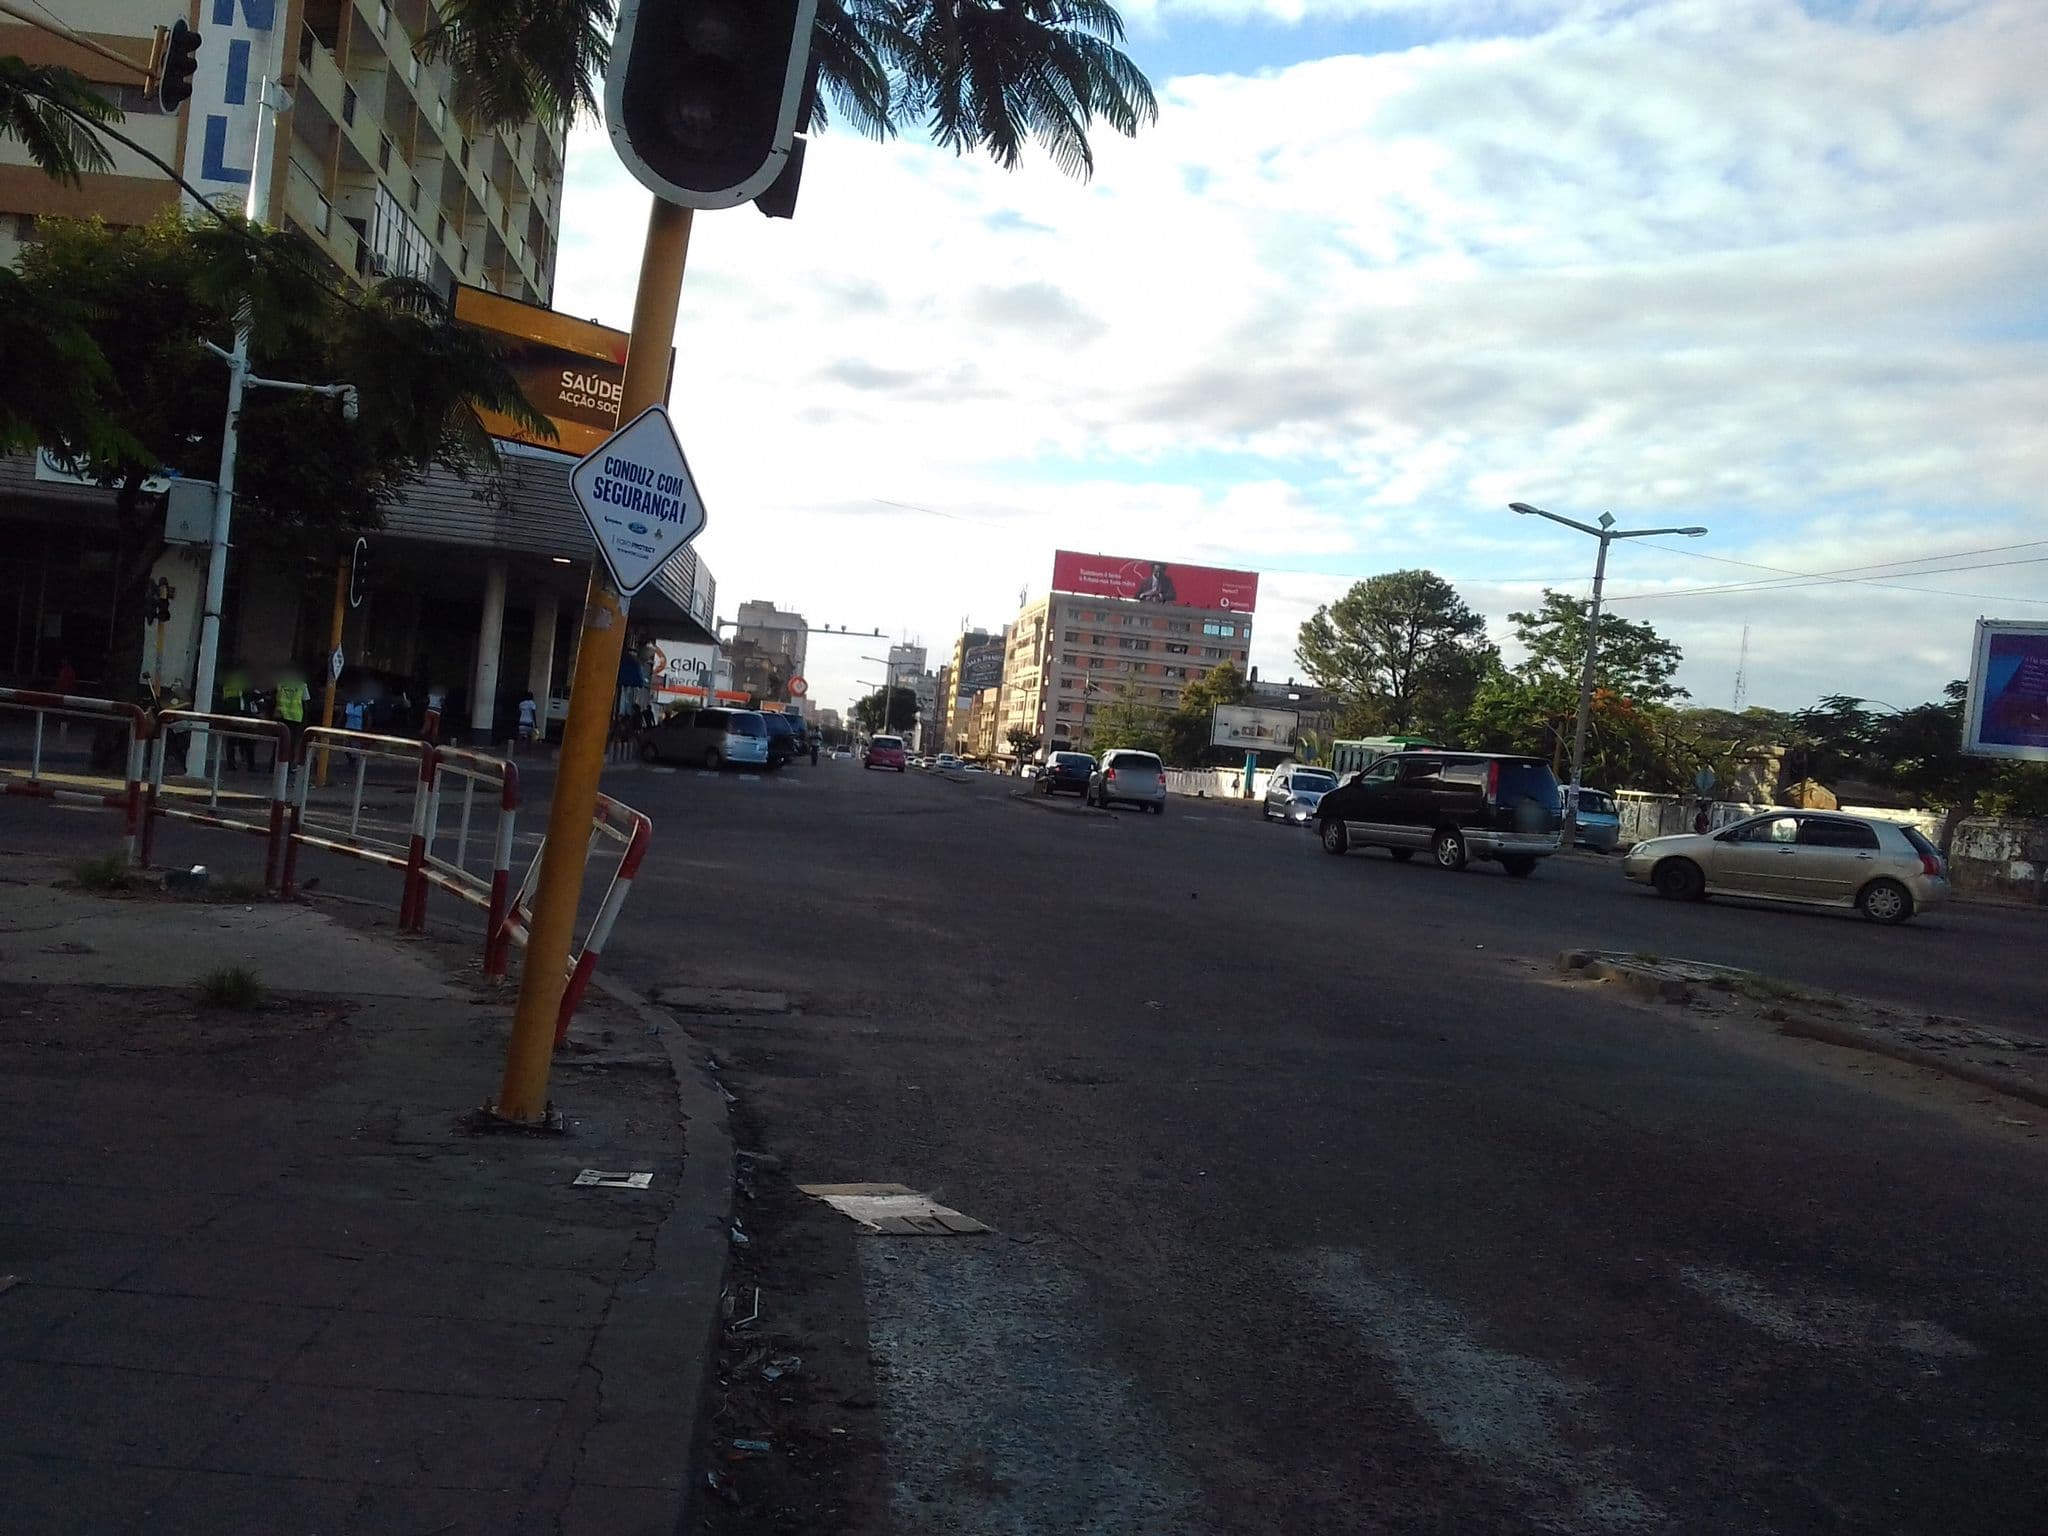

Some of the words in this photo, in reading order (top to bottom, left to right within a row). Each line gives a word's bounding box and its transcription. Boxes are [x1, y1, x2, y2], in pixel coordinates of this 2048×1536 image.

[559, 391, 596, 408] ACÇÃO
[561, 371, 622, 401] SAÚDE
[604, 456, 655, 488] CONDUZ
[657, 473, 684, 497] COM
[593, 476, 686, 524] SEGURANÇA!
[670, 657, 706, 675] galp
